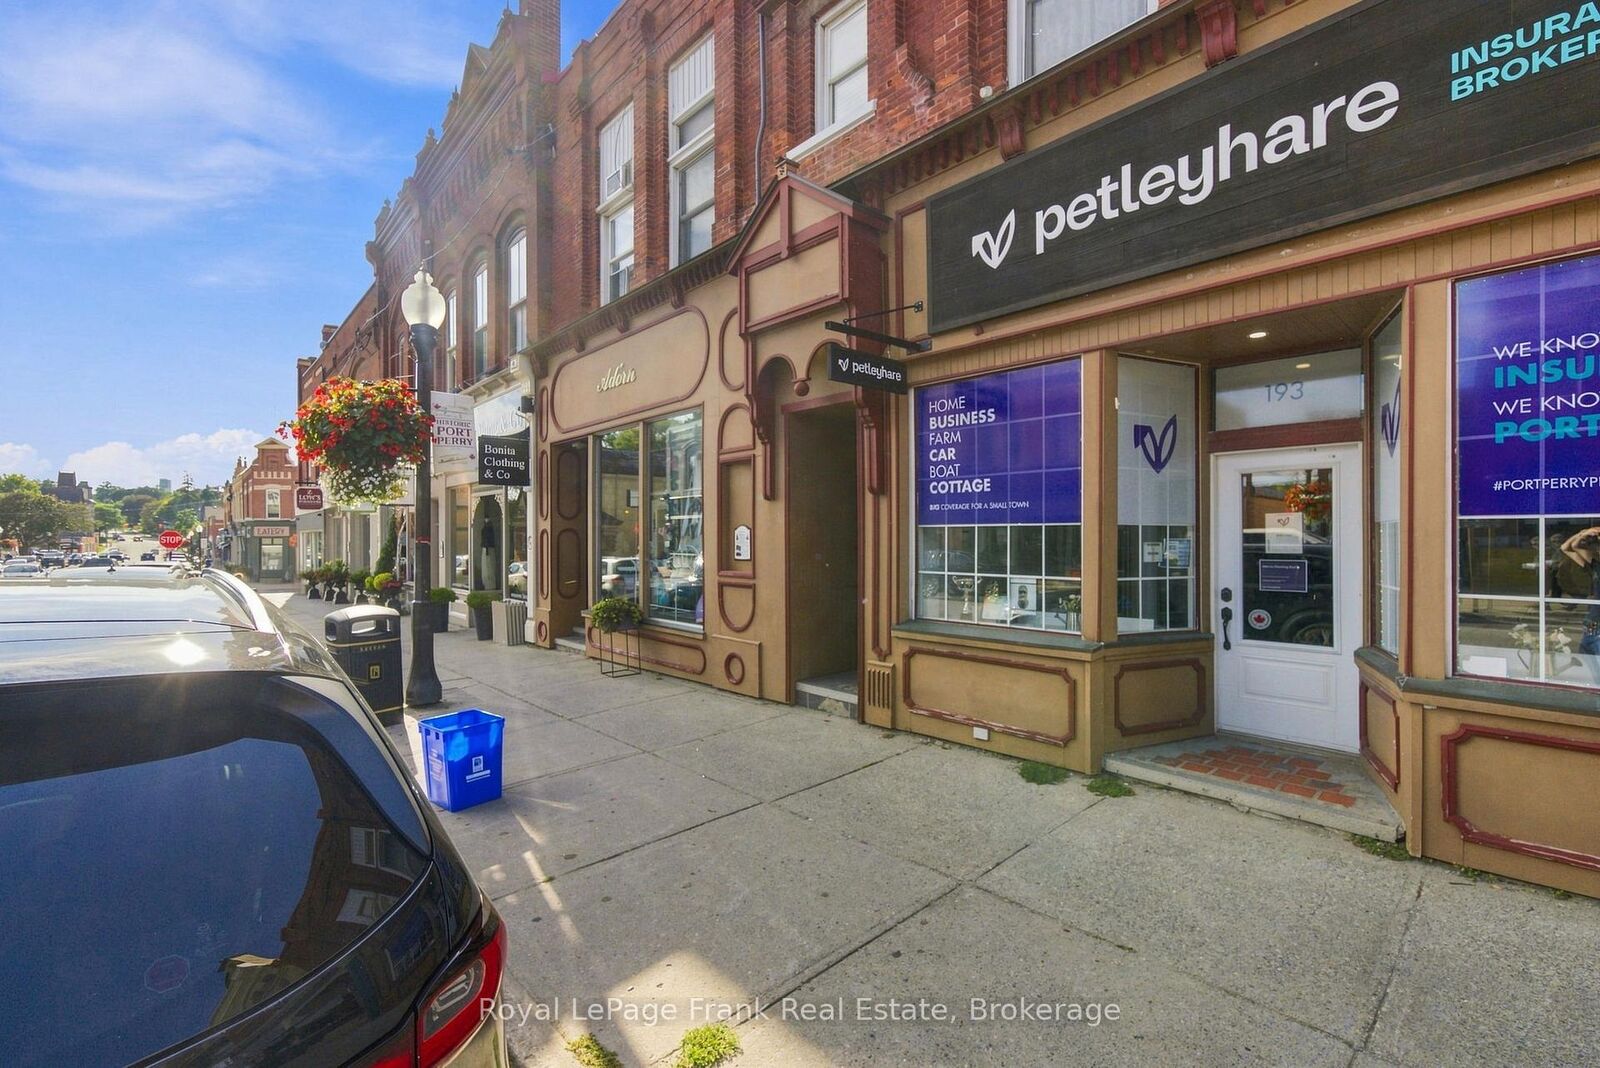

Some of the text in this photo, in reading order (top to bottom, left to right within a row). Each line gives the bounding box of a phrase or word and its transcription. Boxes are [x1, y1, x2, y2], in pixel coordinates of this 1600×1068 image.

[1035, 80, 1399, 255] petleyhare
[1493, 332, 1600, 360] WE KNO
[596, 362, 637, 392] Adorn
[852, 361, 902, 381] petleyhare
[1494, 355, 1600, 388] INSU
[1265, 380, 1304, 402] 193
[929, 396, 965, 413] HOME
[1493, 391, 1600, 415] WE KNO
[436, 419, 471, 428] HISTORIC
[929, 408, 996, 430] BUSINESS
[437, 426, 472, 437] PORT
[1494, 413, 1600, 444] PORT
[437, 436, 473, 446] PERRY
[929, 431, 961, 446] FARM
[484, 444, 515, 455] Bonita
[929, 447, 956, 461] CAR
[484, 457, 525, 470] Clothing
[929, 464, 961, 478] BOAT
[484, 469, 510, 479] & Co
[929, 478, 991, 494] COTTAGE
[1493, 476, 1600, 492] #PORTPERRYP
[971, 502, 982, 510] FOR
[990, 501, 1007, 509] SMALL
[1009, 501, 1029, 509] TOWN
[160, 536, 181, 544] STOP
